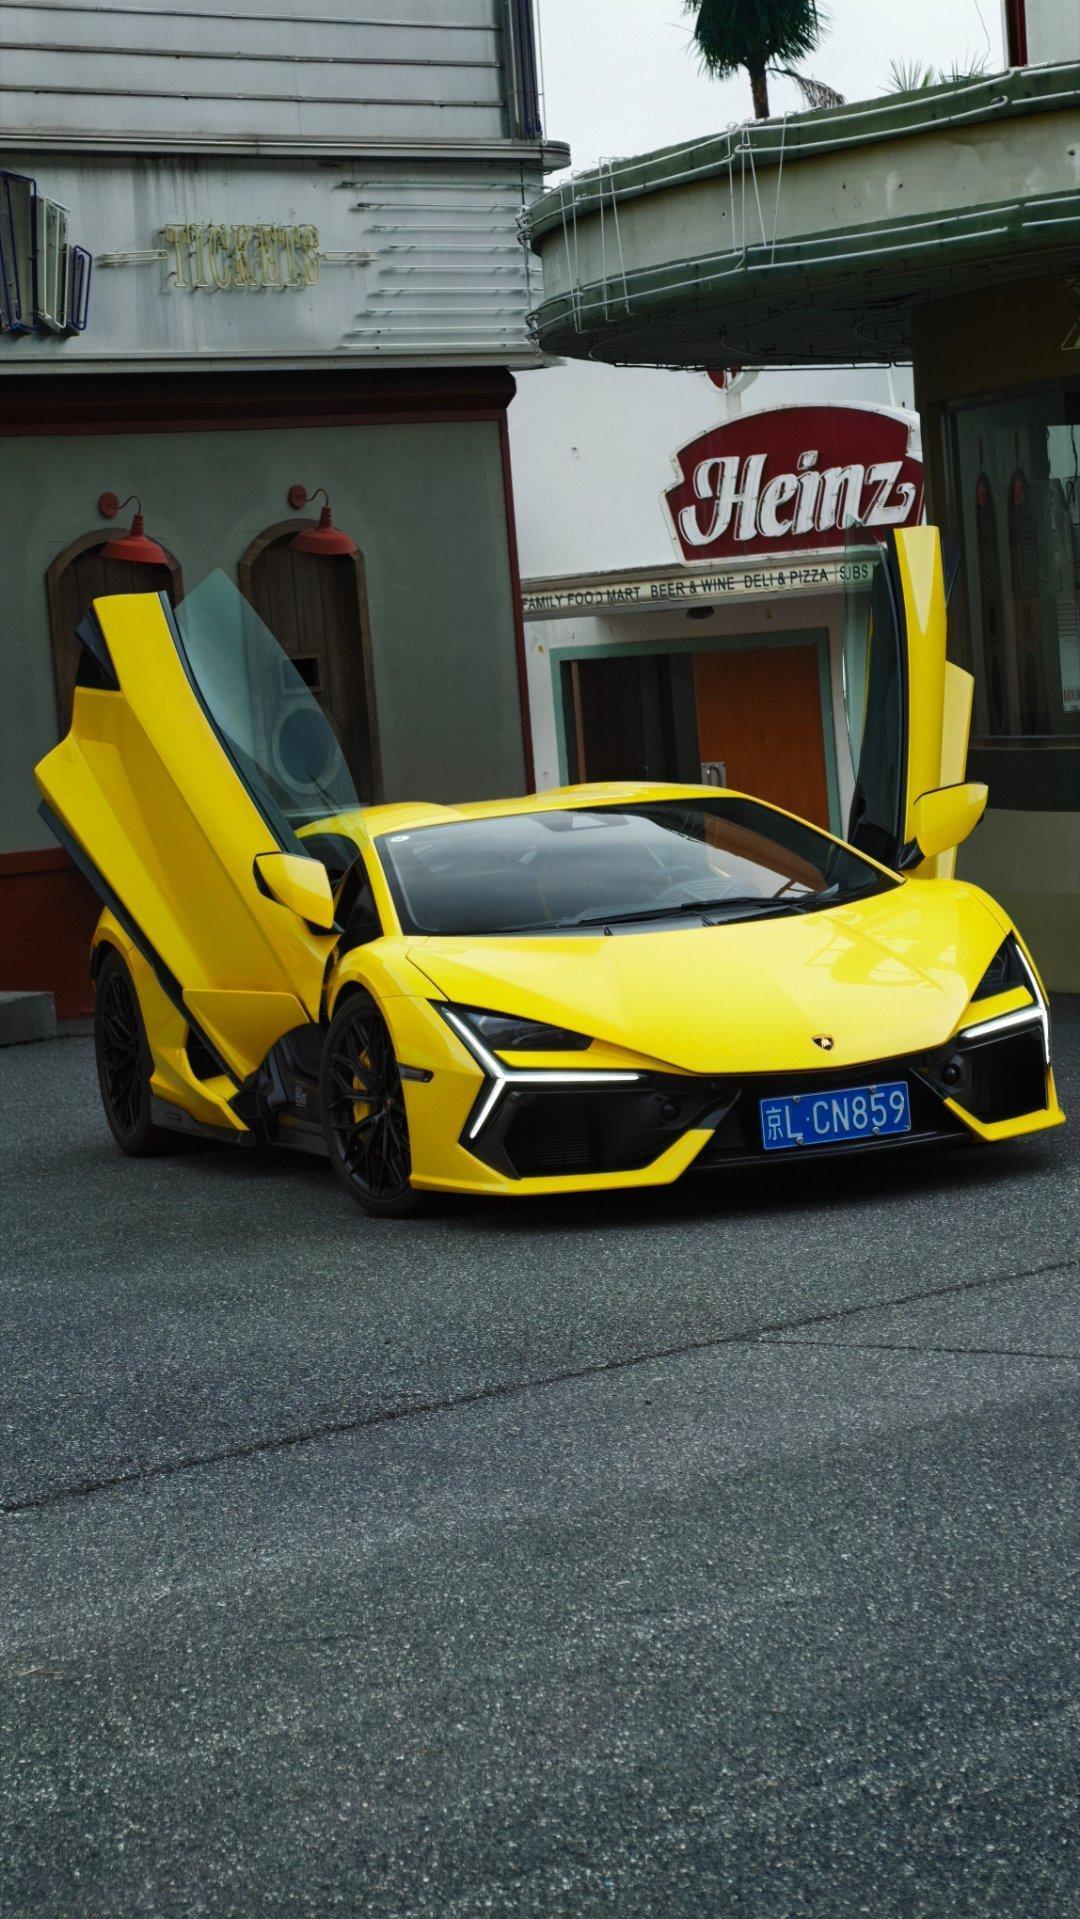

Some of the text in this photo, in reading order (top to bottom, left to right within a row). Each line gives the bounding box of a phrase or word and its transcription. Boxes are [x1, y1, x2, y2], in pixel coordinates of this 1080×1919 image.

[164, 223, 320, 289] TICKETS
[678, 450, 916, 546] Heinz
[522, 594, 563, 611] FAMILY
[606, 586, 641, 602] MART
[650, 582, 685, 599] BEER
[689, 580, 698, 594] &
[700, 576, 736, 593] WINE
[744, 573, 773, 589] DELI
[777, 571, 786, 585] &
[789, 569, 829, 585] PIZZA
[839, 564, 869, 581] SUBS
